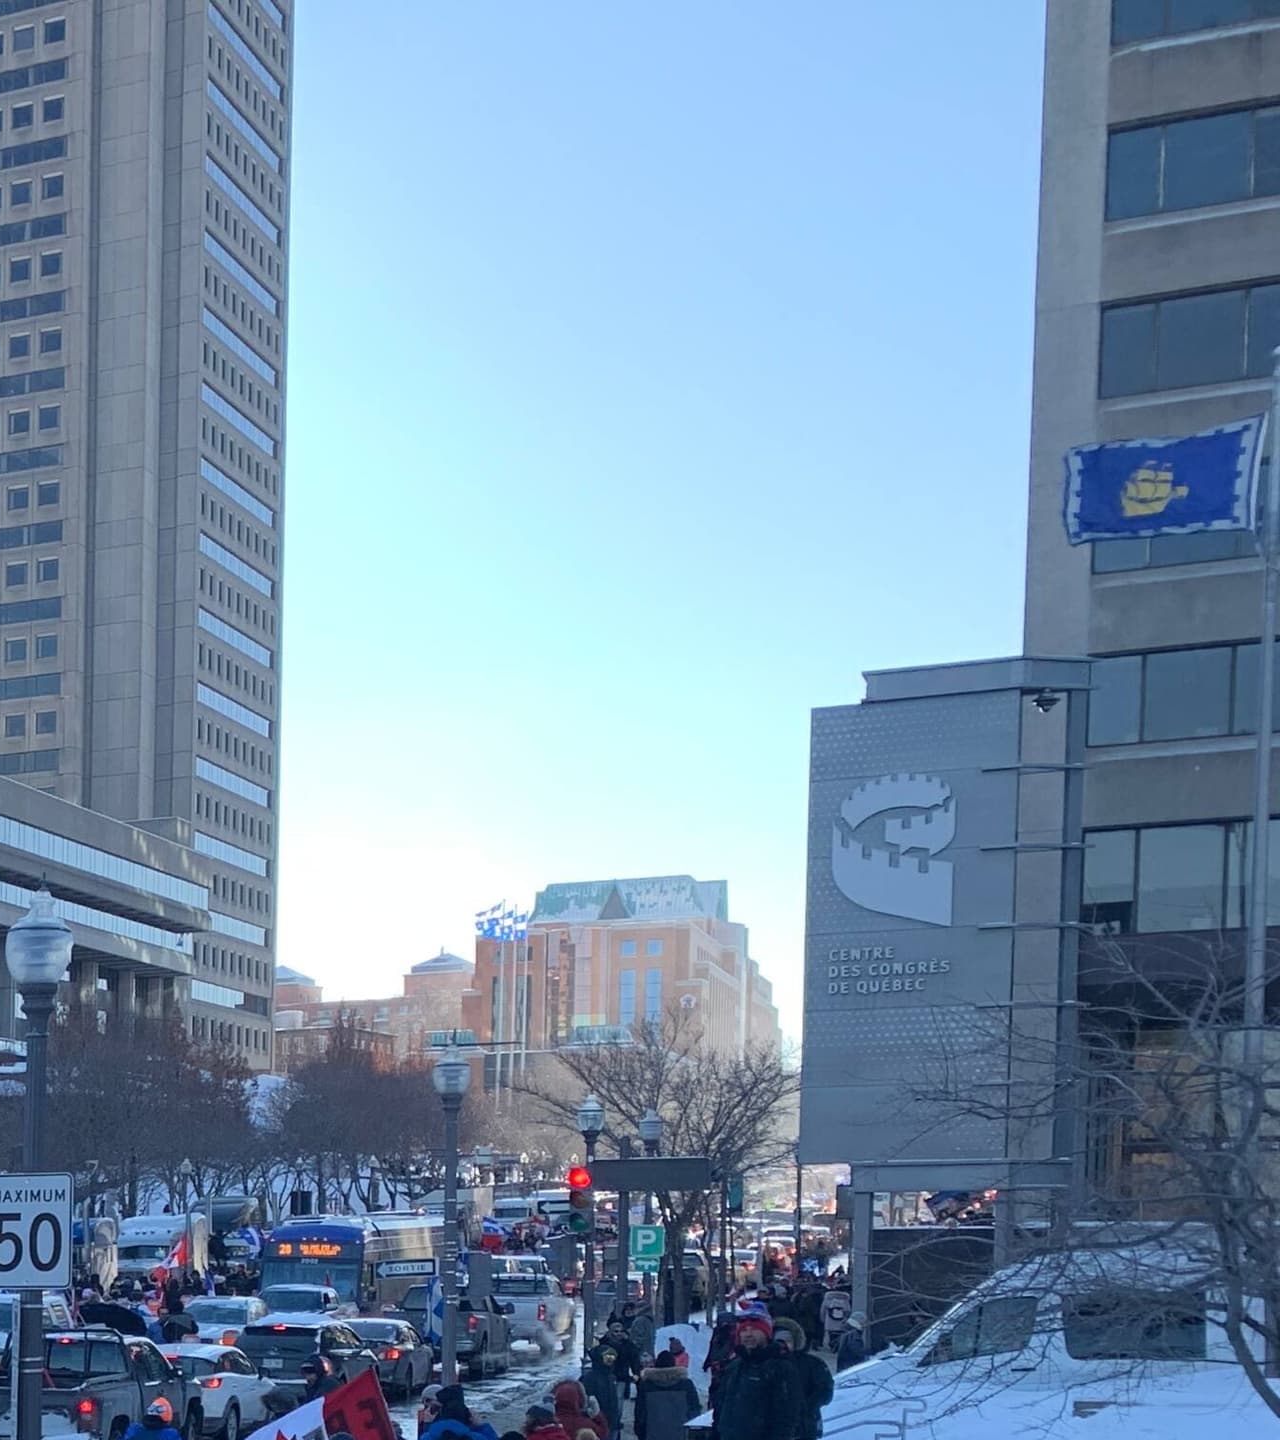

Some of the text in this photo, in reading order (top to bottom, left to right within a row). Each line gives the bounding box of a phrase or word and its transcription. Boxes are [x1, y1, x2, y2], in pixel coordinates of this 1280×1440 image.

[828, 946, 895, 961] CENTRE
[828, 958, 951, 978] DES CONGRÈS
[828, 977, 926, 995] DE QUÉBEC
[638, 1229, 656, 1253] P
[388, 1264, 426, 1273] SORTIE
